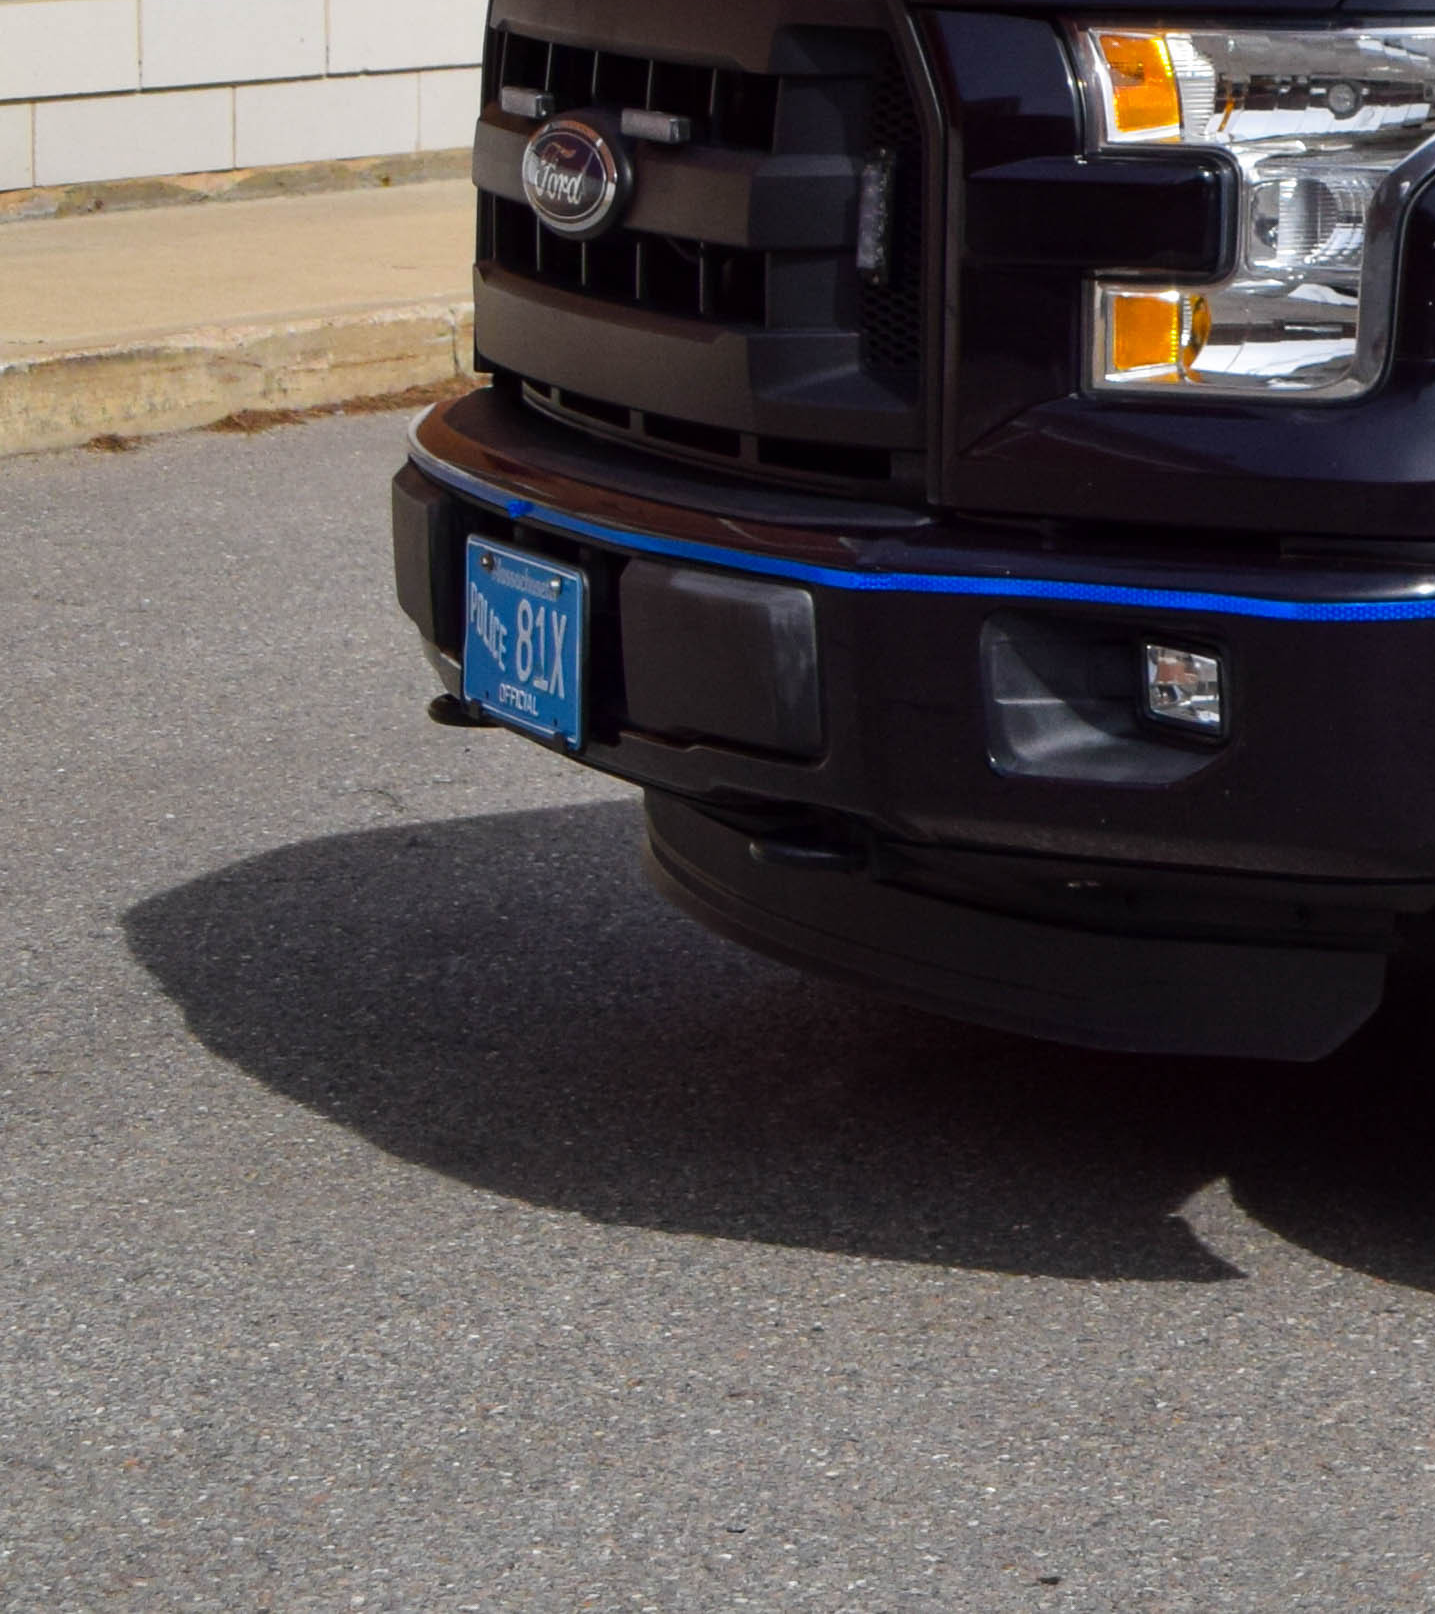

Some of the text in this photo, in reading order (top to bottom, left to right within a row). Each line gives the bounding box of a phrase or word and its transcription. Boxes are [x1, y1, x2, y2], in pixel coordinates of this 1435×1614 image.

[534, 141, 595, 206] Ford
[469, 581, 567, 699] POLICE 81X
[498, 682, 539, 716] OFFICIAL
